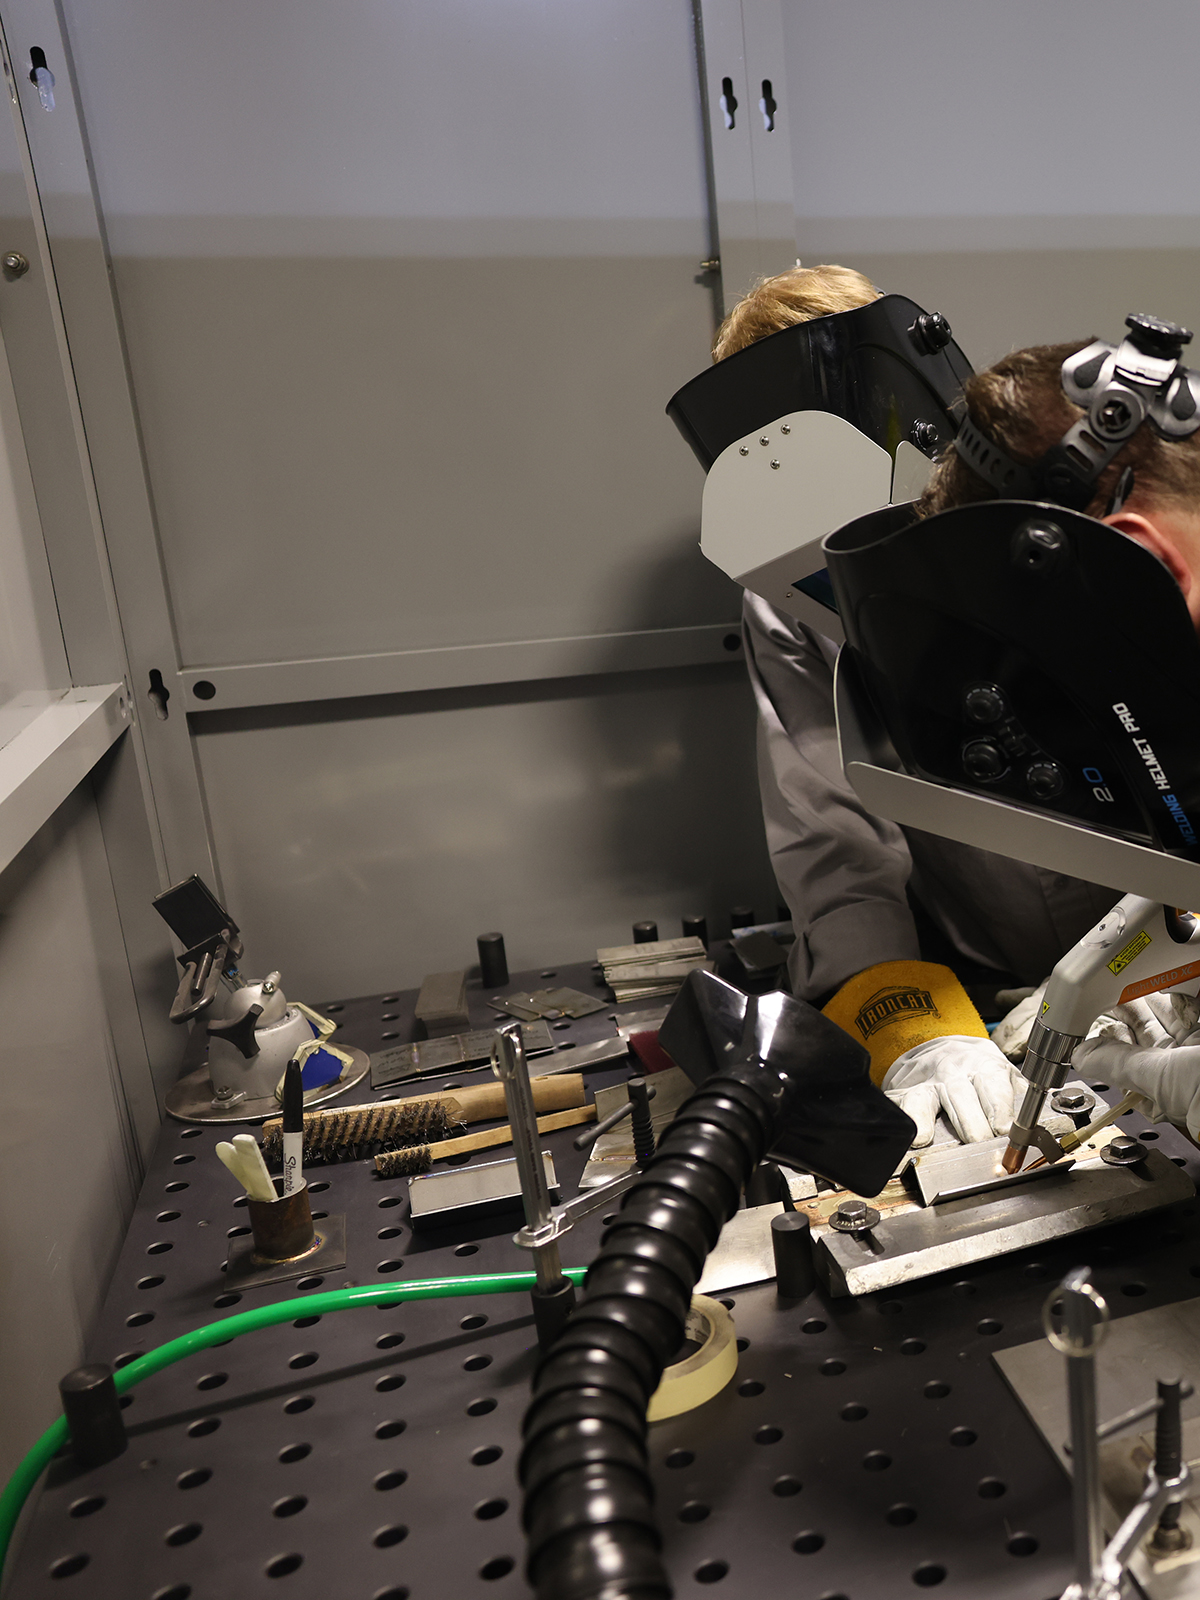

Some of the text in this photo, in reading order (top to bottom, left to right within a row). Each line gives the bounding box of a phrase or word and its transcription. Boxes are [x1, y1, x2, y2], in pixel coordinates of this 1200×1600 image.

[1082, 767, 1115, 802] 2.0
[1111, 702, 1198, 846] WELDING HELMET PRO
[860, 993, 928, 1031] IRONCAT
